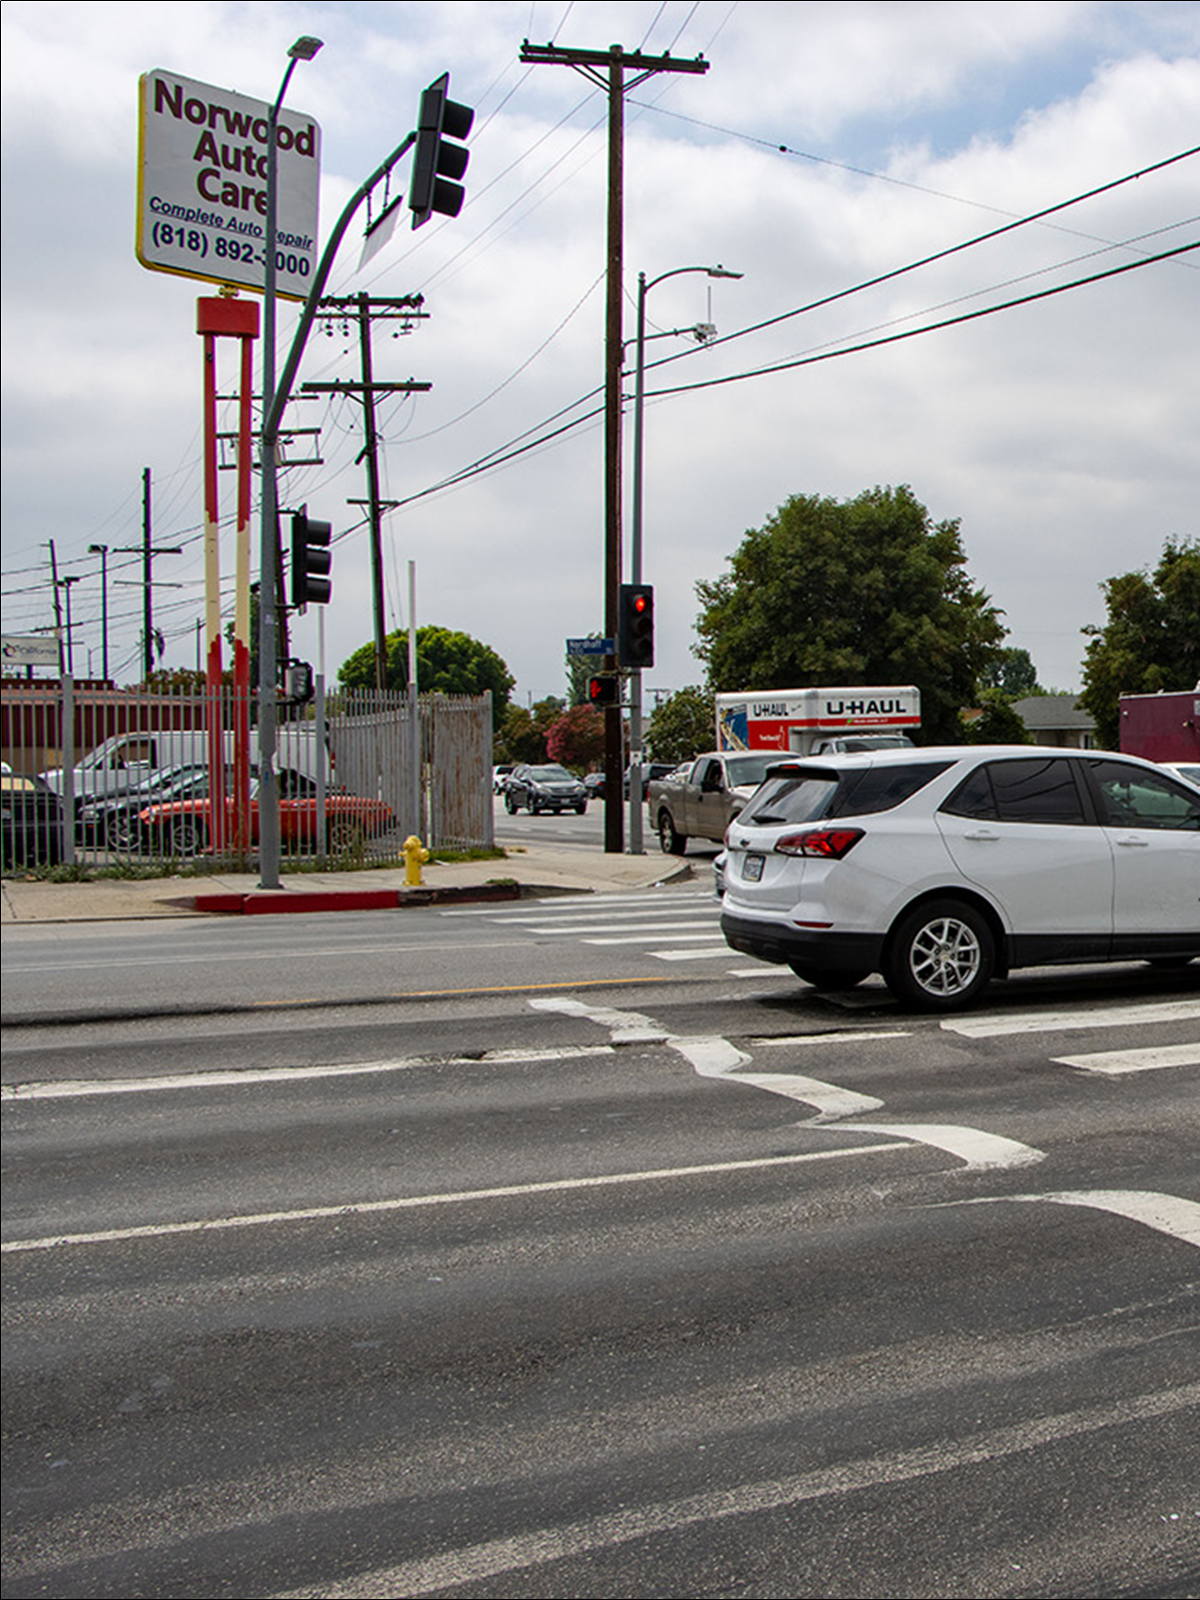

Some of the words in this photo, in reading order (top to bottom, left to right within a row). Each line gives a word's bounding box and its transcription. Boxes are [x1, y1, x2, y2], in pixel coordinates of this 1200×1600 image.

[154, 78, 315, 158] Norwood
[193, 130, 270, 180] Auto
[196, 167, 269, 216] Care
[149, 196, 224, 228] Complete
[227, 216, 264, 238] Auto
[274, 228, 314, 251] epair
[152, 221, 208, 258] (818)
[753, 703, 789, 717] U-HAUL
[827, 700, 907, 715] U-HAUL
